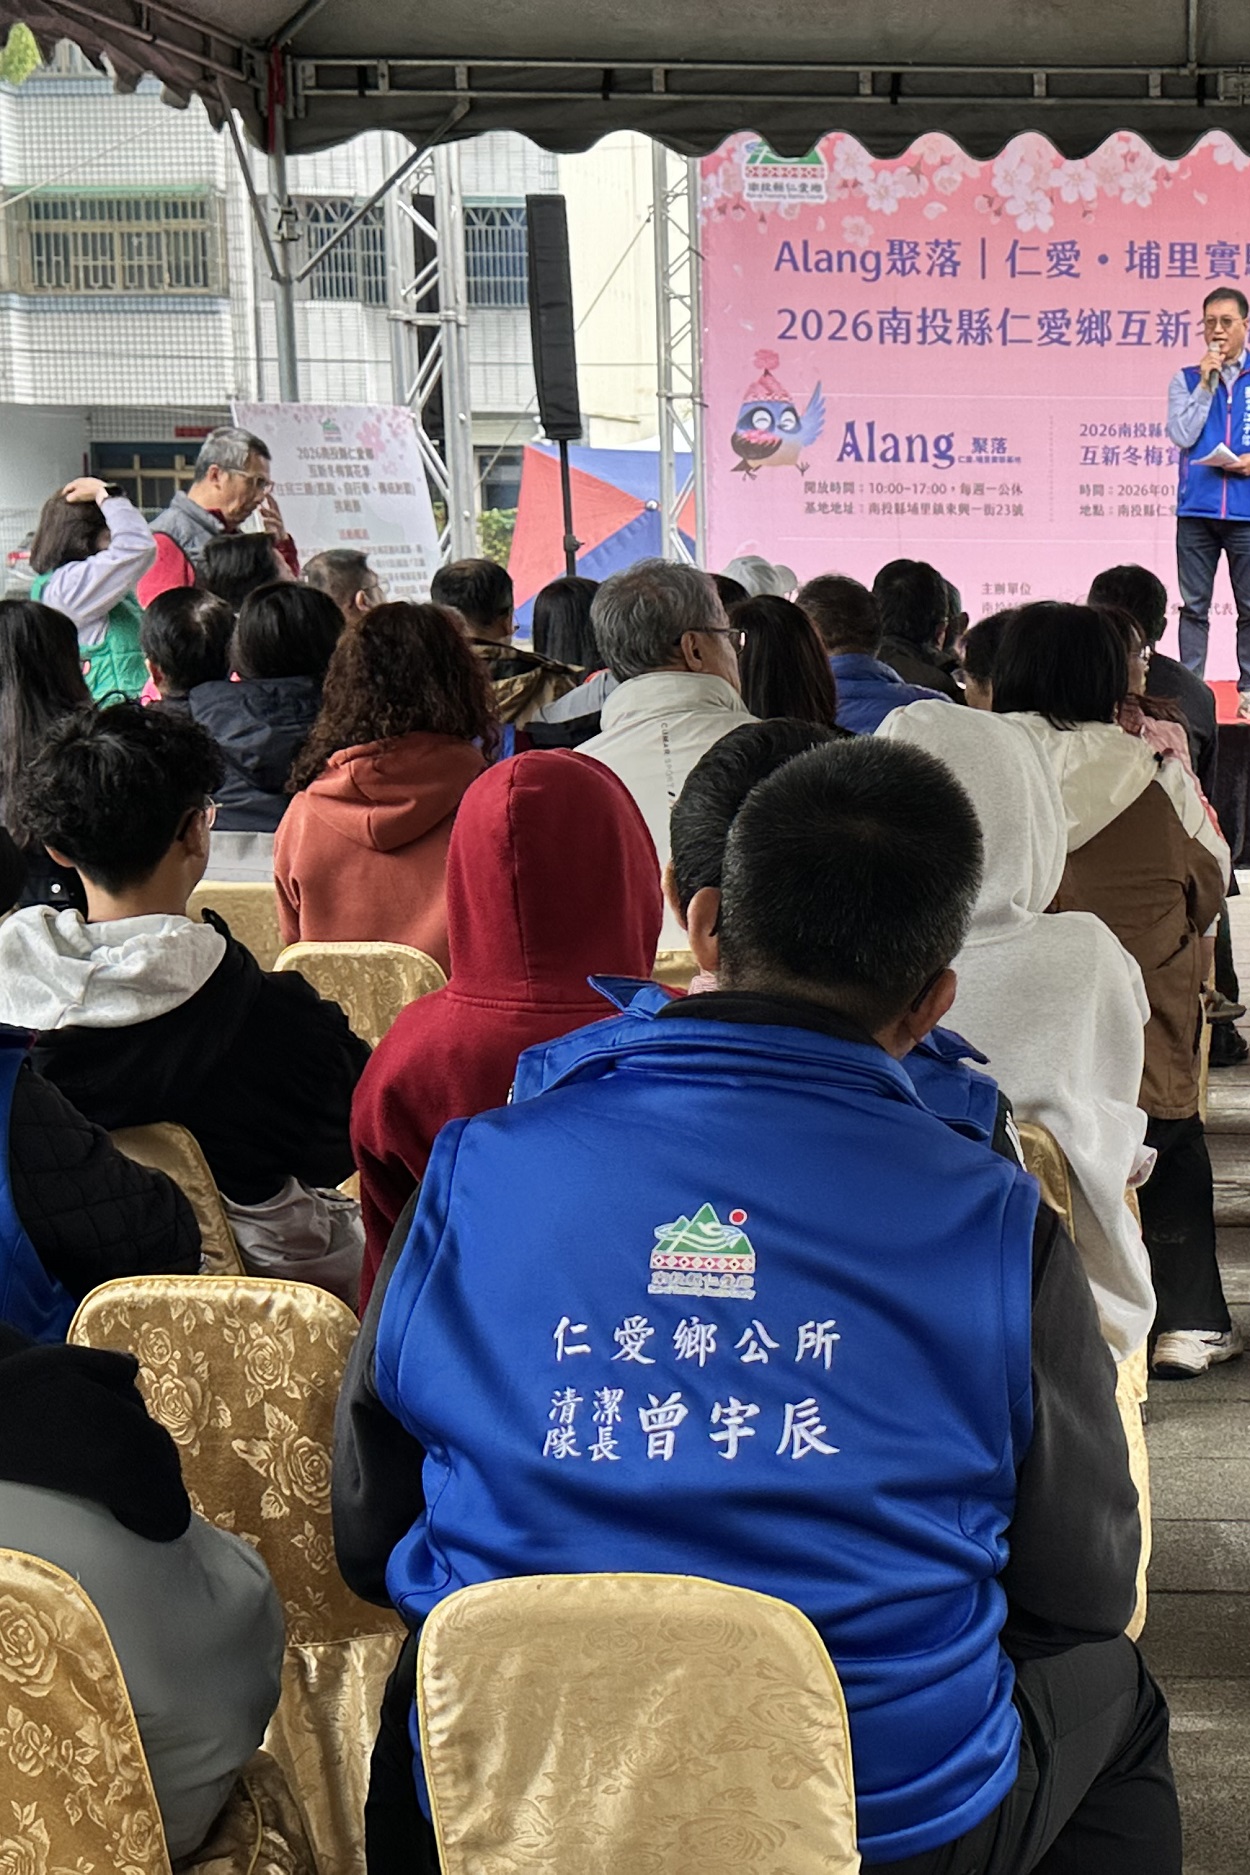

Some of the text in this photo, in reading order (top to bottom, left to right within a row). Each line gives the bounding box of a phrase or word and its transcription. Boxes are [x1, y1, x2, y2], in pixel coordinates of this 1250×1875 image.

[836, 419, 955, 470] Alang
[971, 436, 1008, 454] 聚落
[1079, 422, 1170, 438] 2026南投縣
[981, 582, 1032, 596] 主辦單位
[553, 1314, 841, 1370] 仁愛鄉公所
[548, 1386, 624, 1425] 清潔
[542, 1425, 622, 1462] 隊長
[637, 1391, 841, 1461] 曾宇辰
